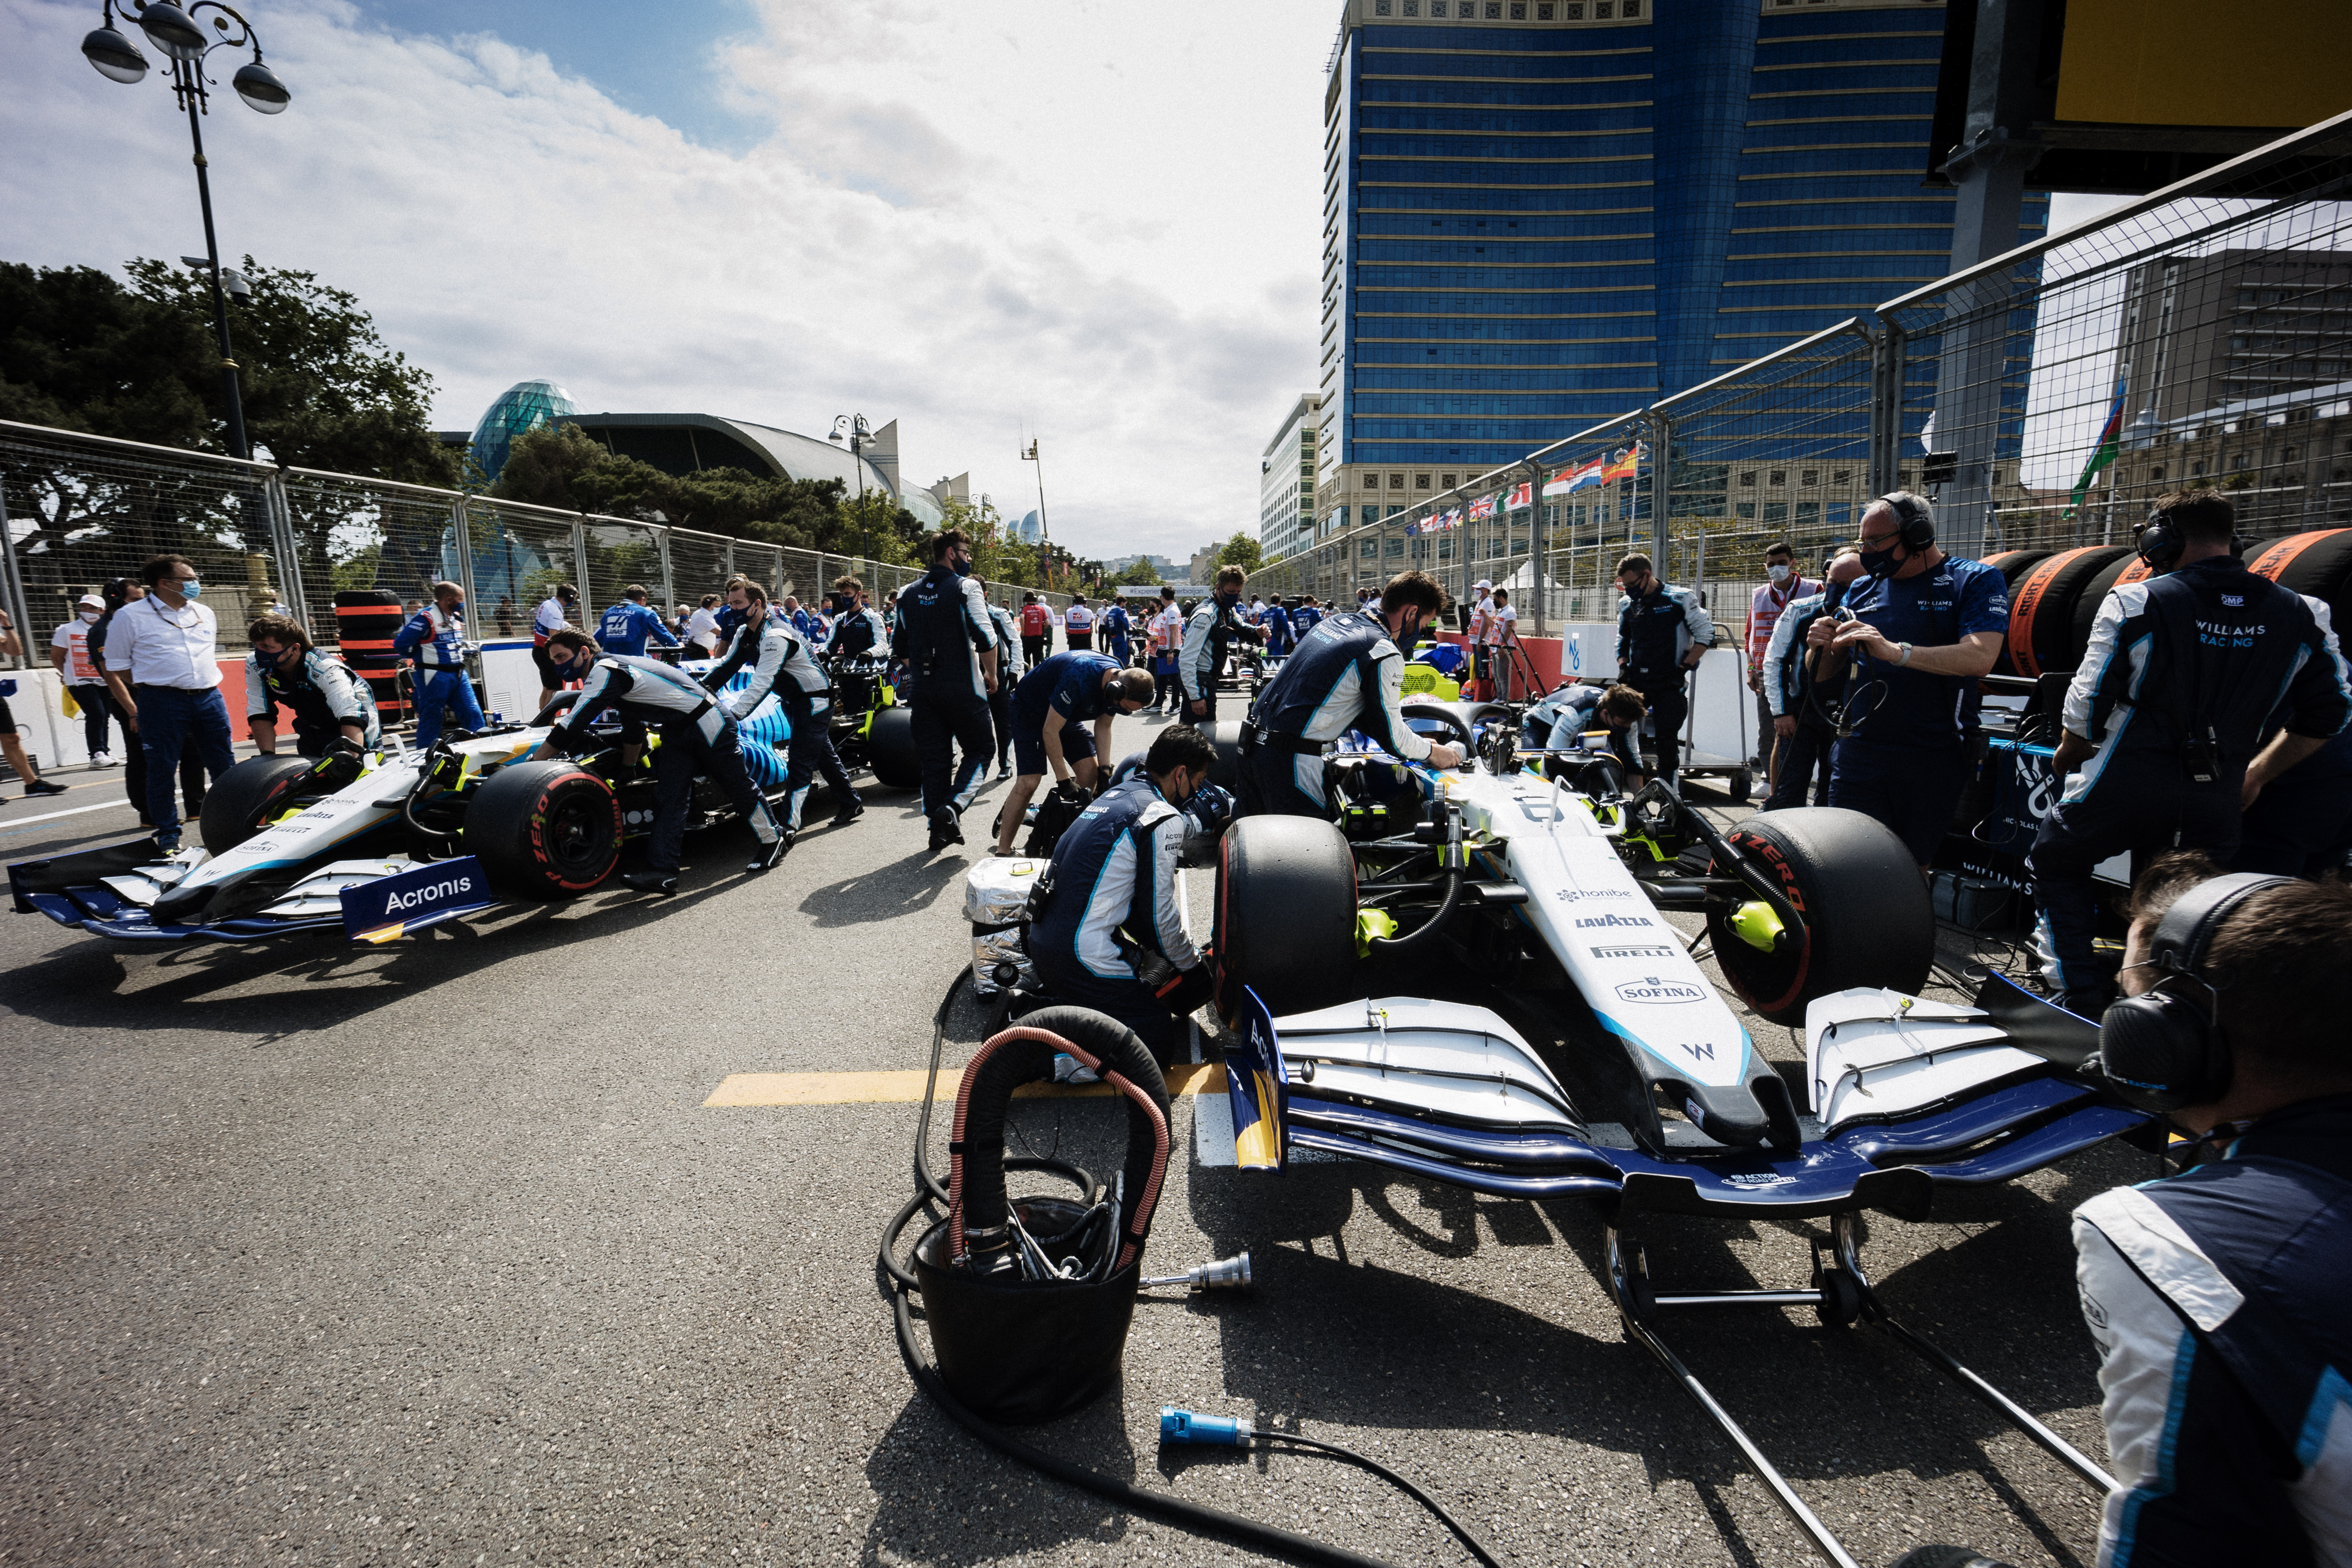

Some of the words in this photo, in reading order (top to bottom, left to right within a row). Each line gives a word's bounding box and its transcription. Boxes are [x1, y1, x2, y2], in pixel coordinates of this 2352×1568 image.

[2126, 561, 2145, 580] RE
[2018, 582, 2039, 617] RIGHT
[2221, 596, 2243, 604] OMP
[1316, 623, 1344, 640] WILLIAMS
[2195, 619, 2265, 635] WILLIAMS
[1311, 631, 1333, 644] RACING
[2016, 650, 2035, 677] ONT
[1256, 732, 1267, 742] MP
[774, 745, 789, 758] Dori
[531, 794, 549, 863] ZERO
[2003, 817, 2035, 829] NICOLAS
[1746, 834, 1806, 912] ZERO
[385, 877, 471, 915] Acronis
[1575, 914, 1654, 928] LAVAZZA
[1589, 945, 1675, 958] PIRELLI
[1624, 988, 1700, 998] SOFINA
[1251, 1018, 1276, 1106] Acronis
